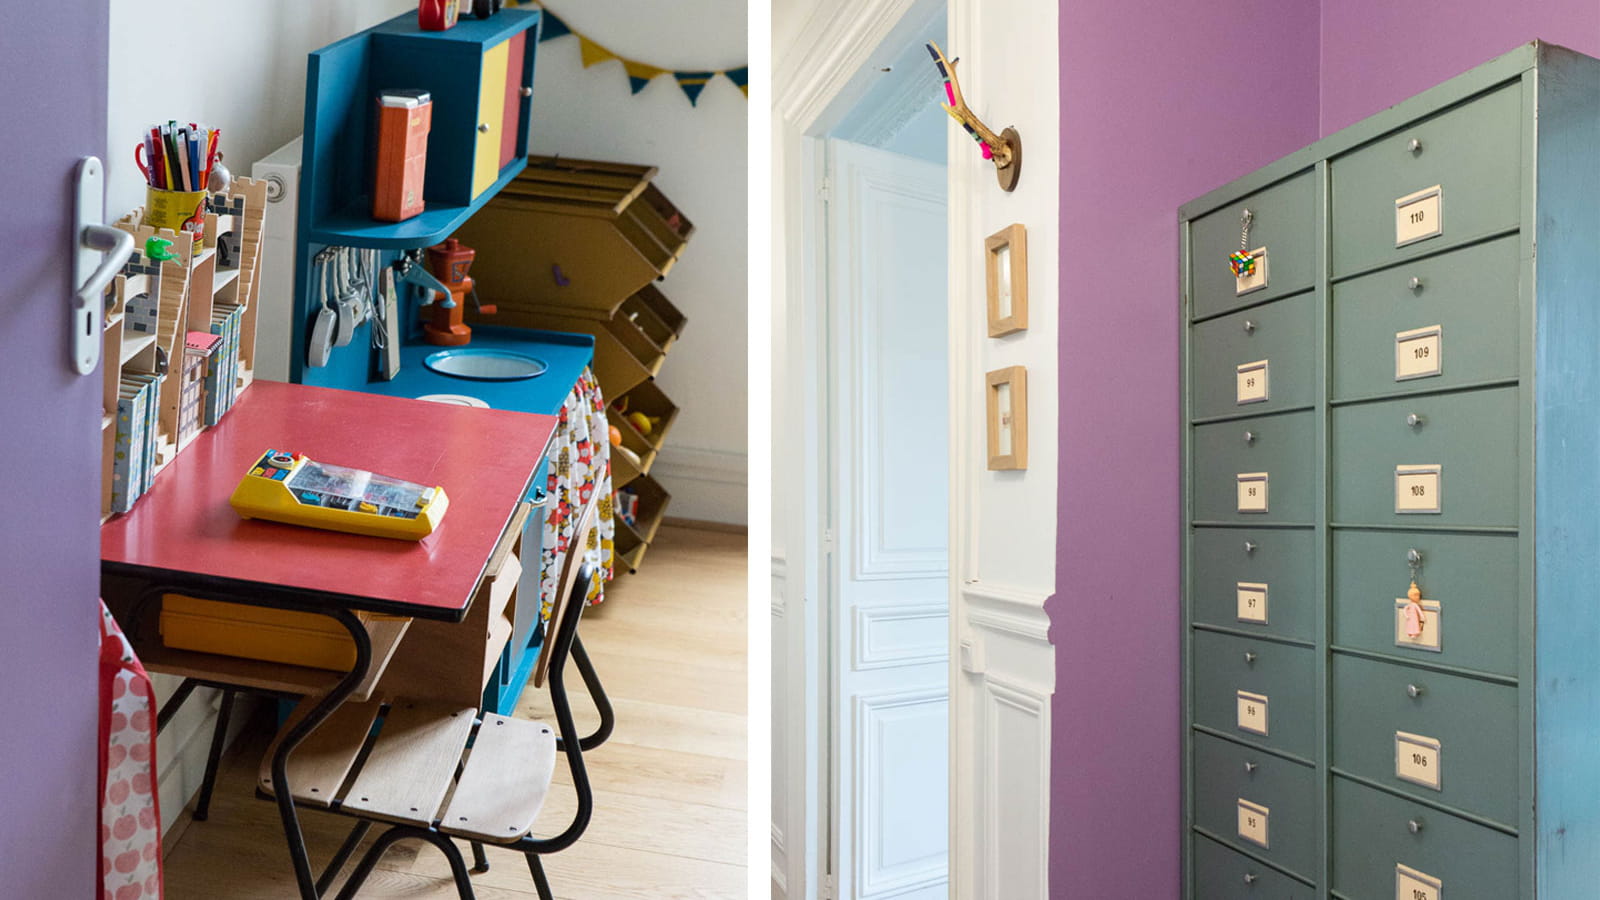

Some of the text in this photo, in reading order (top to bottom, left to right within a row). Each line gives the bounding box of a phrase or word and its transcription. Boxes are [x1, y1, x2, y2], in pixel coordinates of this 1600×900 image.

[1410, 210, 1424, 224] 110
[1414, 346, 1430, 360] 109
[1410, 485, 1425, 497] 108
[1247, 598, 1257, 608] 97
[1412, 753, 1427, 766] 106
